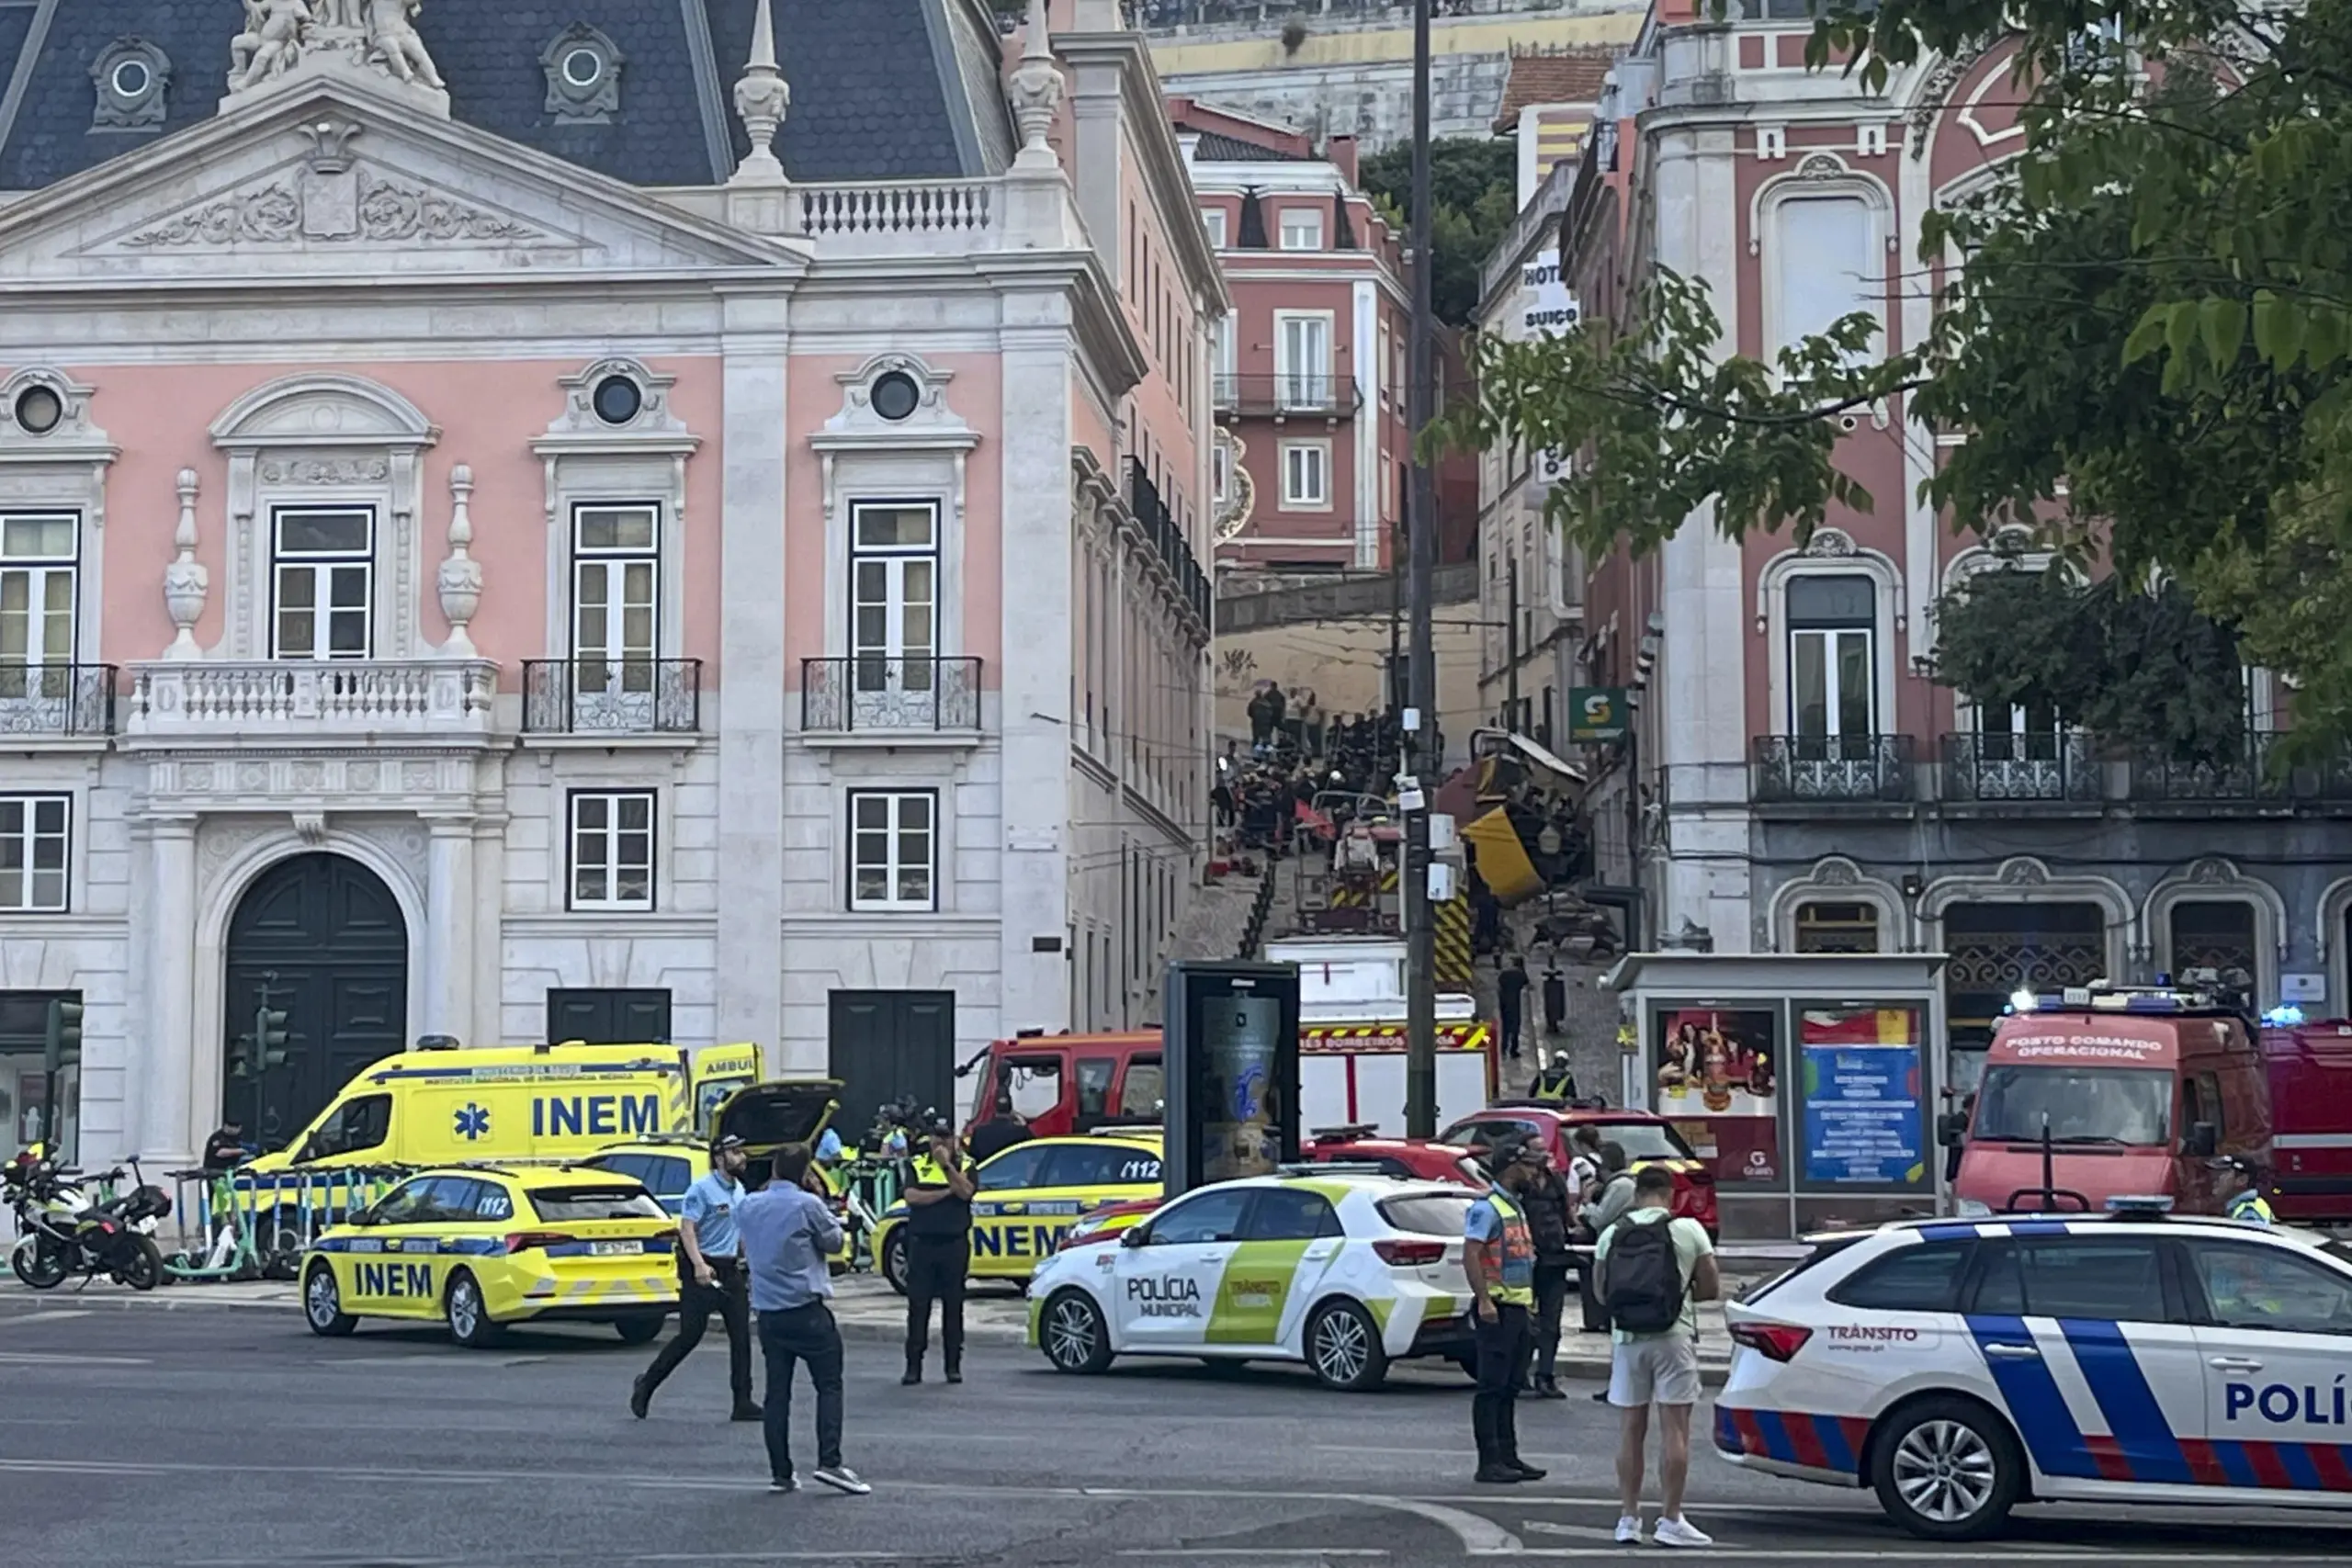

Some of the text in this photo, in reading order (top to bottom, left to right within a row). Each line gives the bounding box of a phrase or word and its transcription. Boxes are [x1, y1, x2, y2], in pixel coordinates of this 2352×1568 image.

[1524, 265, 1560, 286] HOT
[2006, 1035, 2163, 1051] POSTO COMANDO
[2018, 1045, 2147, 1061] OPERACIONAL
[532, 1094, 660, 1136] INEM
[973, 1225, 1067, 1257] NEM
[355, 1262, 432, 1298] INEM
[1127, 1273, 1201, 1301] POLÍCIA
[1139, 1303, 1202, 1317] MUNICIPAL
[1826, 1322, 1918, 1341] TRÂNSITO
[2225, 1372, 2352, 1425] POLÍ
